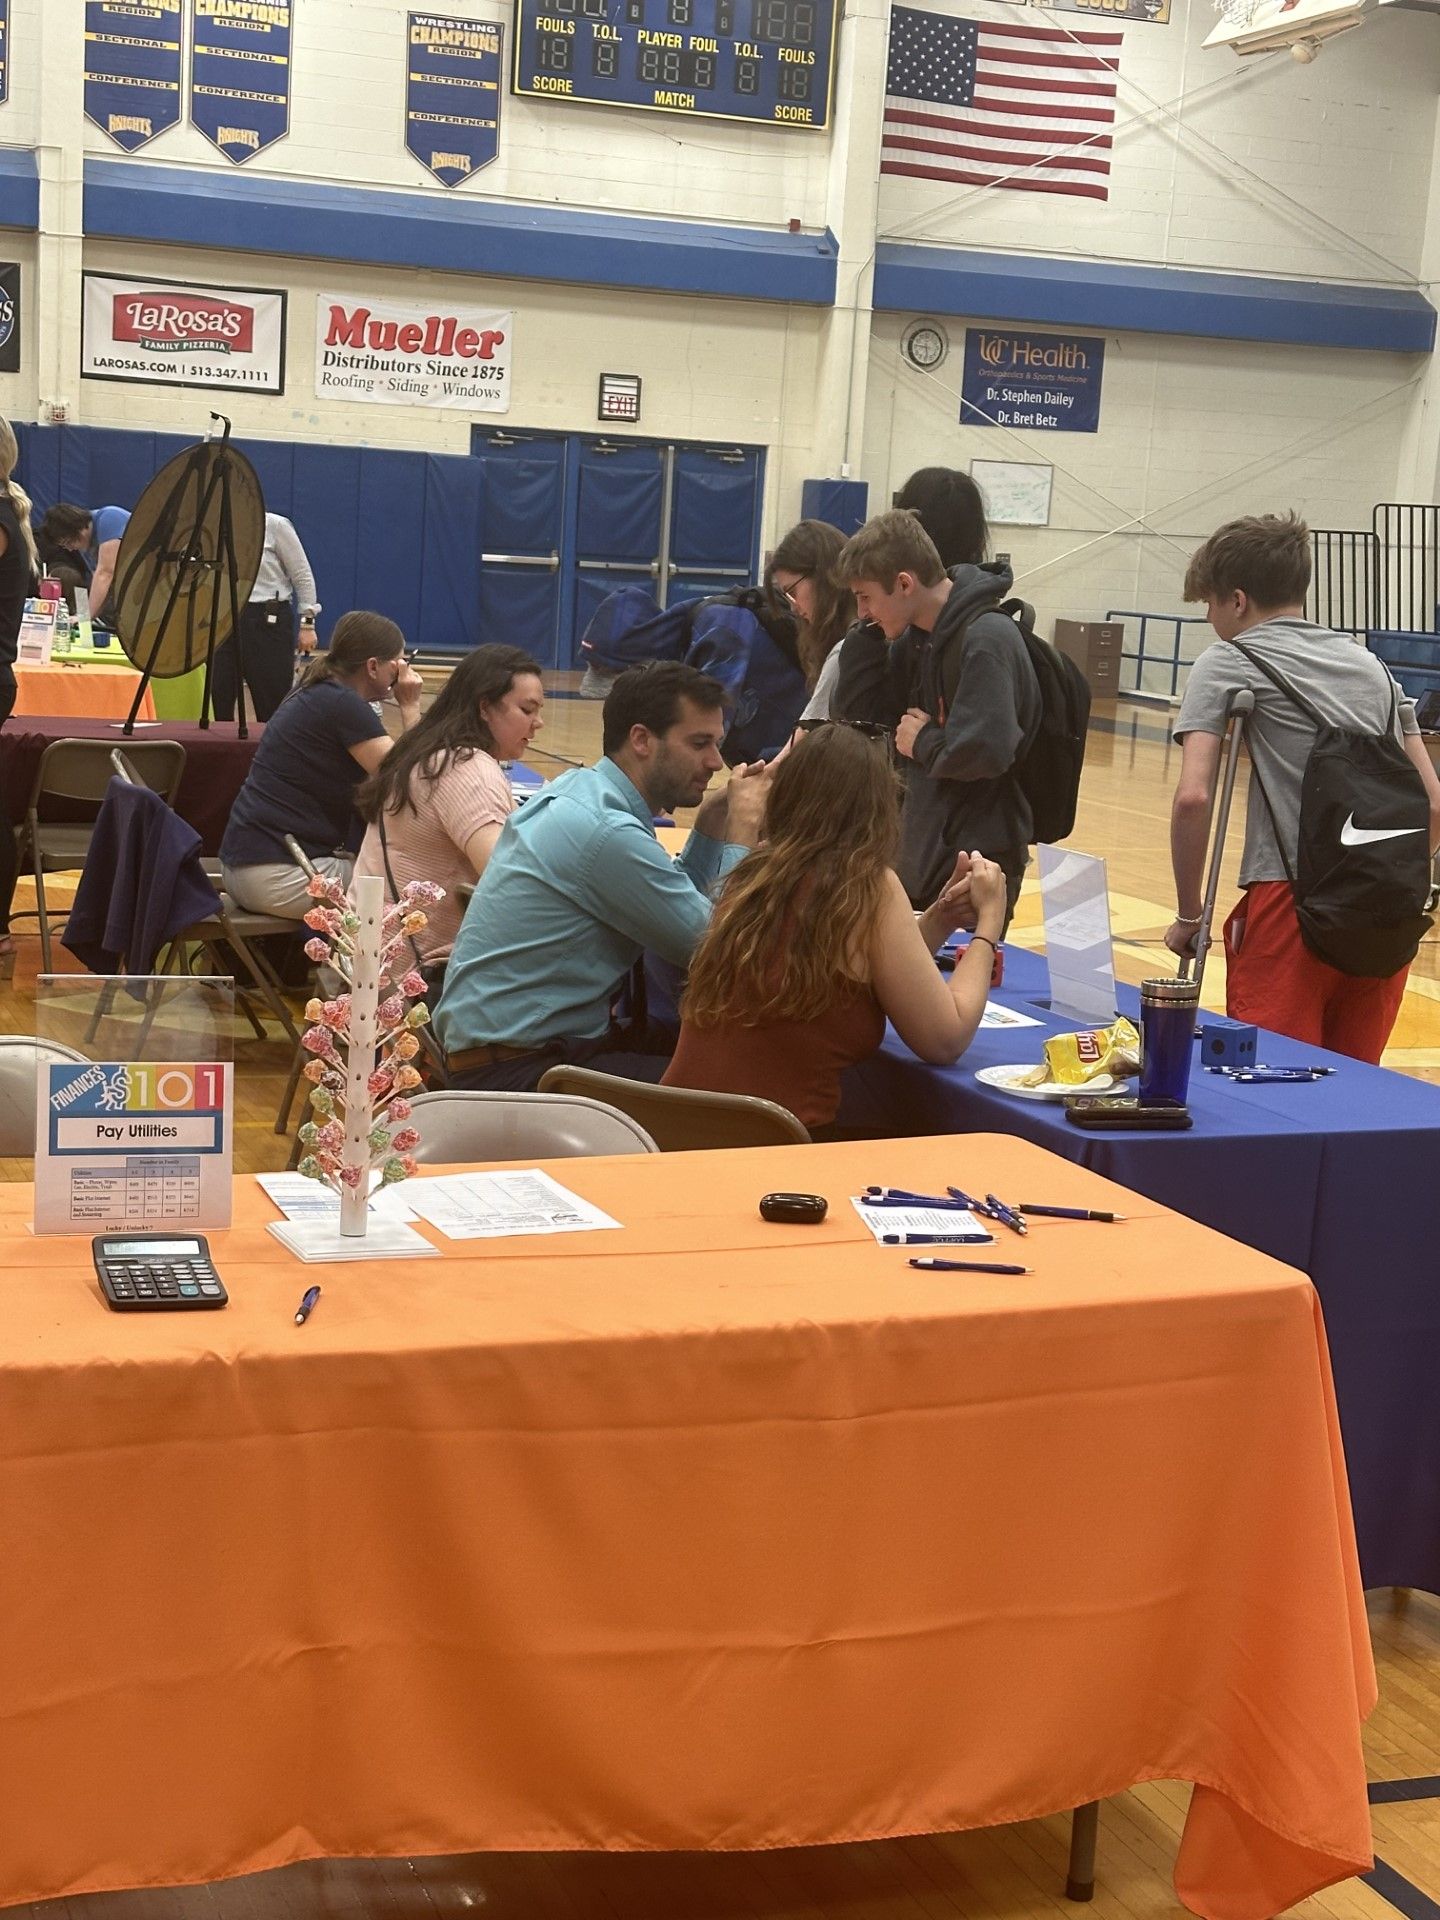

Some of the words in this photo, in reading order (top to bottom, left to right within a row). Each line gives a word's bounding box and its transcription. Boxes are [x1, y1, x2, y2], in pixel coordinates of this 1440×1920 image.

[108, 5, 156, 17] REGION
[195, 0, 289, 28] CHAMPIONS
[219, 19, 266, 31] REGION
[414, 16, 497, 34] WRESTLING
[535, 16, 576, 35] FOULS
[591, 23, 623, 41] T.O.L.
[95, 34, 167, 48] SECTIONAL
[410, 25, 499, 54] CHAMPIONS
[637, 29, 683, 49] PLAYER
[689, 36, 720, 53] FOUL
[206, 47, 276, 62] SECTIONAL
[432, 47, 477, 58] REGION
[733, 42, 764, 59] T.O.L.
[778, 48, 815, 65] FOULS
[89, 73, 173, 88] CONFERENCE
[420, 74, 487, 88] SECTIONAL
[532, 75, 573, 93] SCORE
[198, 86, 281, 102] CONFERENCE
[654, 90, 695, 108] MATCH
[413, 112, 491, 127] CONFERENCE
[774, 105, 813, 122] SCORE
[108, 113, 152, 137] KNIGHTS
[217, 126, 260, 150] KNIGHTS
[431, 151, 472, 174] KNIGHTS
[324, 304, 505, 360] Mueller
[145, 339, 180, 350] FAMILY
[183, 341, 226, 351] PIZZERIA
[93, 357, 177, 374] LAROSAS.COM
[190, 366, 269, 382] 513.347.1111
[322, 350, 422, 374] Distributors
[426, 360, 469, 378] Since
[471, 366, 505, 380] 1875
[321, 372, 374, 391] Roofing
[387, 378, 429, 396] Siding
[442, 382, 501, 399] Windows
[1033, 372, 1056, 382] Sports
[608, 396, 636, 415] EXIT
[987, 387, 1000, 401] Dr.
[1002, 388, 1041, 405] Stephen
[1044, 391, 1074, 408] Dailey
[998, 410, 1011, 424] Dr.
[1014, 412, 1034, 425] Bret
[1036, 413, 1058, 427] Betz
[50, 1064, 107, 1111] FINANCES
[96, 1125, 124, 1140] Pay
[128, 1124, 178, 1138] Utilities
